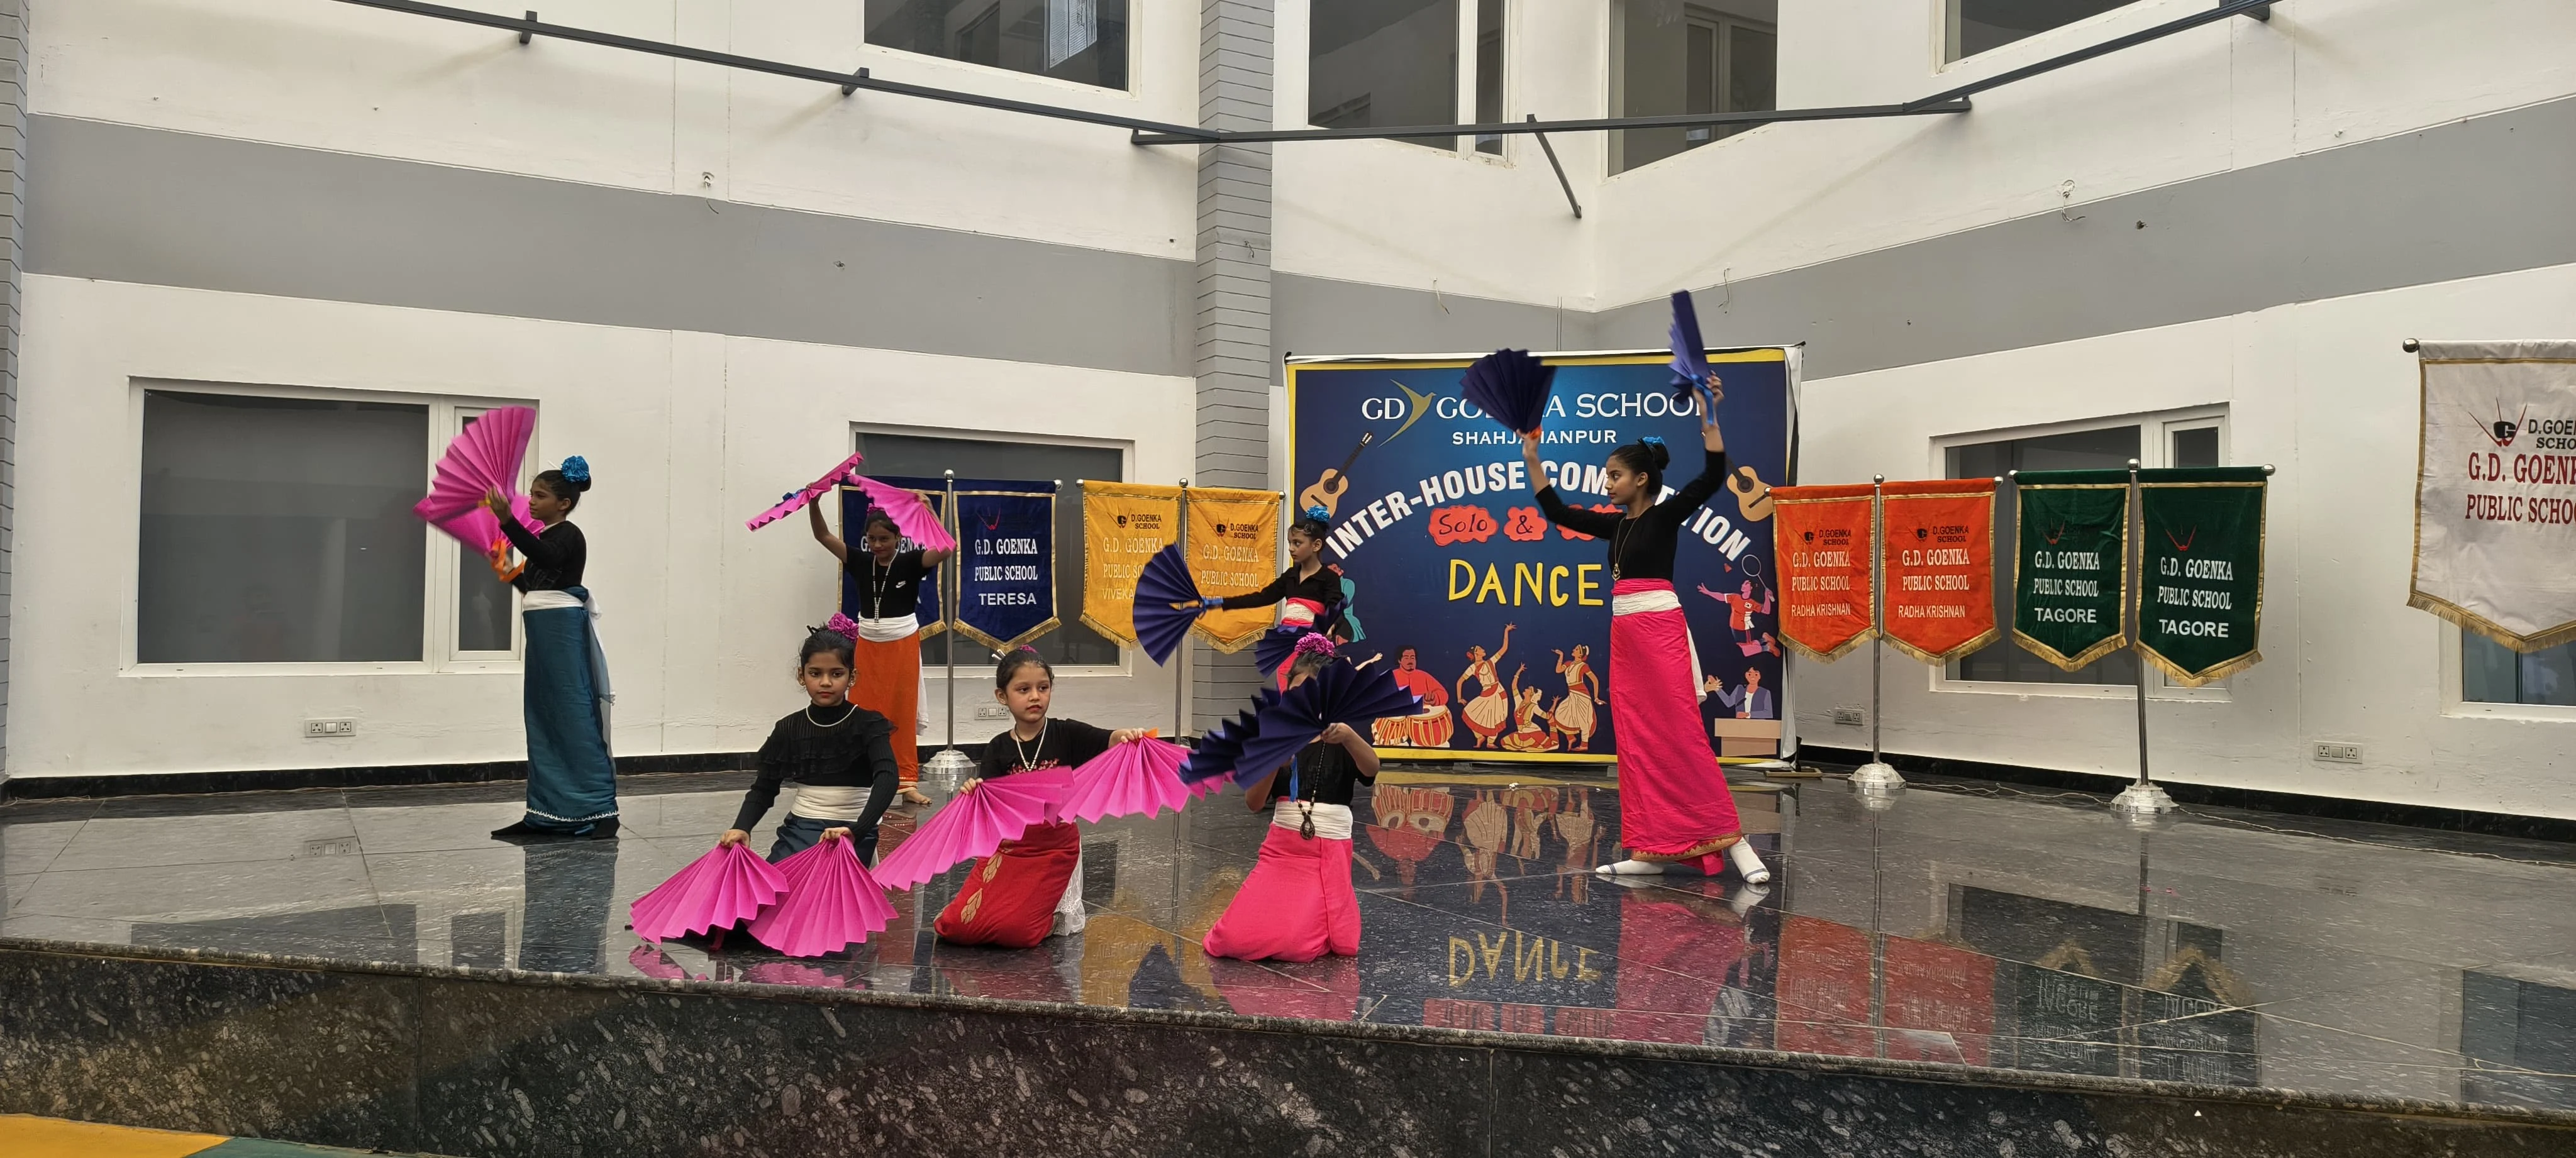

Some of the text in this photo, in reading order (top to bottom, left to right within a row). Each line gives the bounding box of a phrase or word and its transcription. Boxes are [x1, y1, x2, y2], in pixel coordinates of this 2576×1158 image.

[1362, 397, 1405, 420] GD
[1436, 395, 1566, 419] GOA
[2528, 419, 2576, 435] D.GOE
[1452, 429, 1617, 445] SHAHJANPUR
[2536, 437, 2576, 449] SCHO
[2468, 452, 2576, 485] G.D. GOEN
[2465, 494, 2576, 524] PUBLIC SCHO
[1439, 513, 1534, 535] Solo &
[975, 538, 1038, 555] G.D. GOENKA
[1103, 537, 1163, 553] G.D. GOENKA
[1203, 543, 1260, 563] G.D. GOENKA
[1792, 551, 1851, 568] G.D. GOENKA
[1902, 548, 1970, 566] G.D. GOENKA
[2035, 551, 2100, 570] G.D. GOENKA
[974, 565, 1038, 582] PUBLIC SCHOOL
[1103, 563, 1131, 578] PUBLIC
[2160, 556, 2234, 581] G.D. GOENKA
[1201, 570, 1258, 587] PUBLIC SCHOOL
[1448, 559, 1604, 607] DANCE
[1791, 575, 1850, 591] PUBLIC SCHOOL
[1902, 575, 1970, 591] PUBLIC SCHOOL
[1102, 588, 1134, 600] VIVEKA
[2033, 578, 2099, 597] PUBLIC SCHOOL
[978, 593, 1037, 605] TERESA
[2157, 586, 2232, 610] PUBLIC SCHOOL
[1791, 604, 1851, 617] RADHA KRISHNAN
[1898, 605, 1965, 618] RADHA KRISHNAN
[2034, 607, 2097, 623] TAGORE
[2158, 619, 2229, 638] TAGORE
